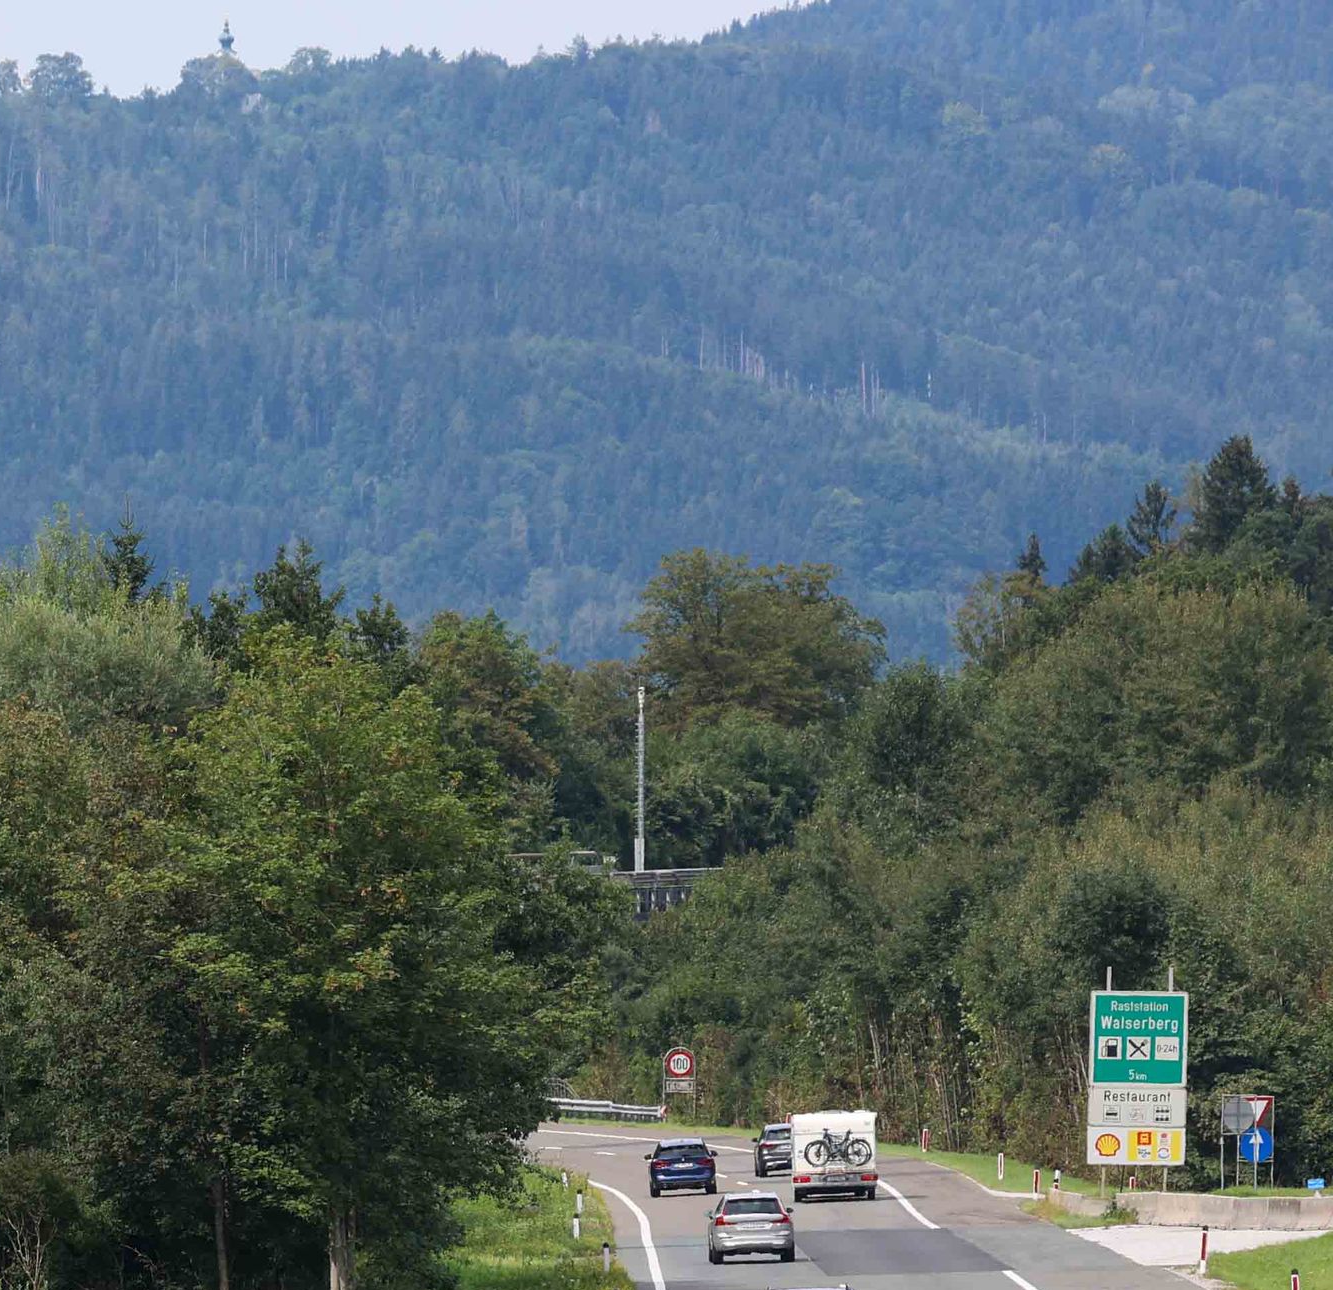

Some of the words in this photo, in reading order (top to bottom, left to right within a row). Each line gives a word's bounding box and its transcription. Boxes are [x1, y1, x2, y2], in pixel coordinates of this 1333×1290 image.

[1111, 1001, 1169, 1012] Raststation
[1101, 1015, 1179, 1034] Walserberg
[673, 1057, 688, 1070] 100
[1128, 1069, 1135, 1081] 5
[1136, 1072, 1147, 1080] km
[1104, 1090, 1171, 1102] Restaurant
